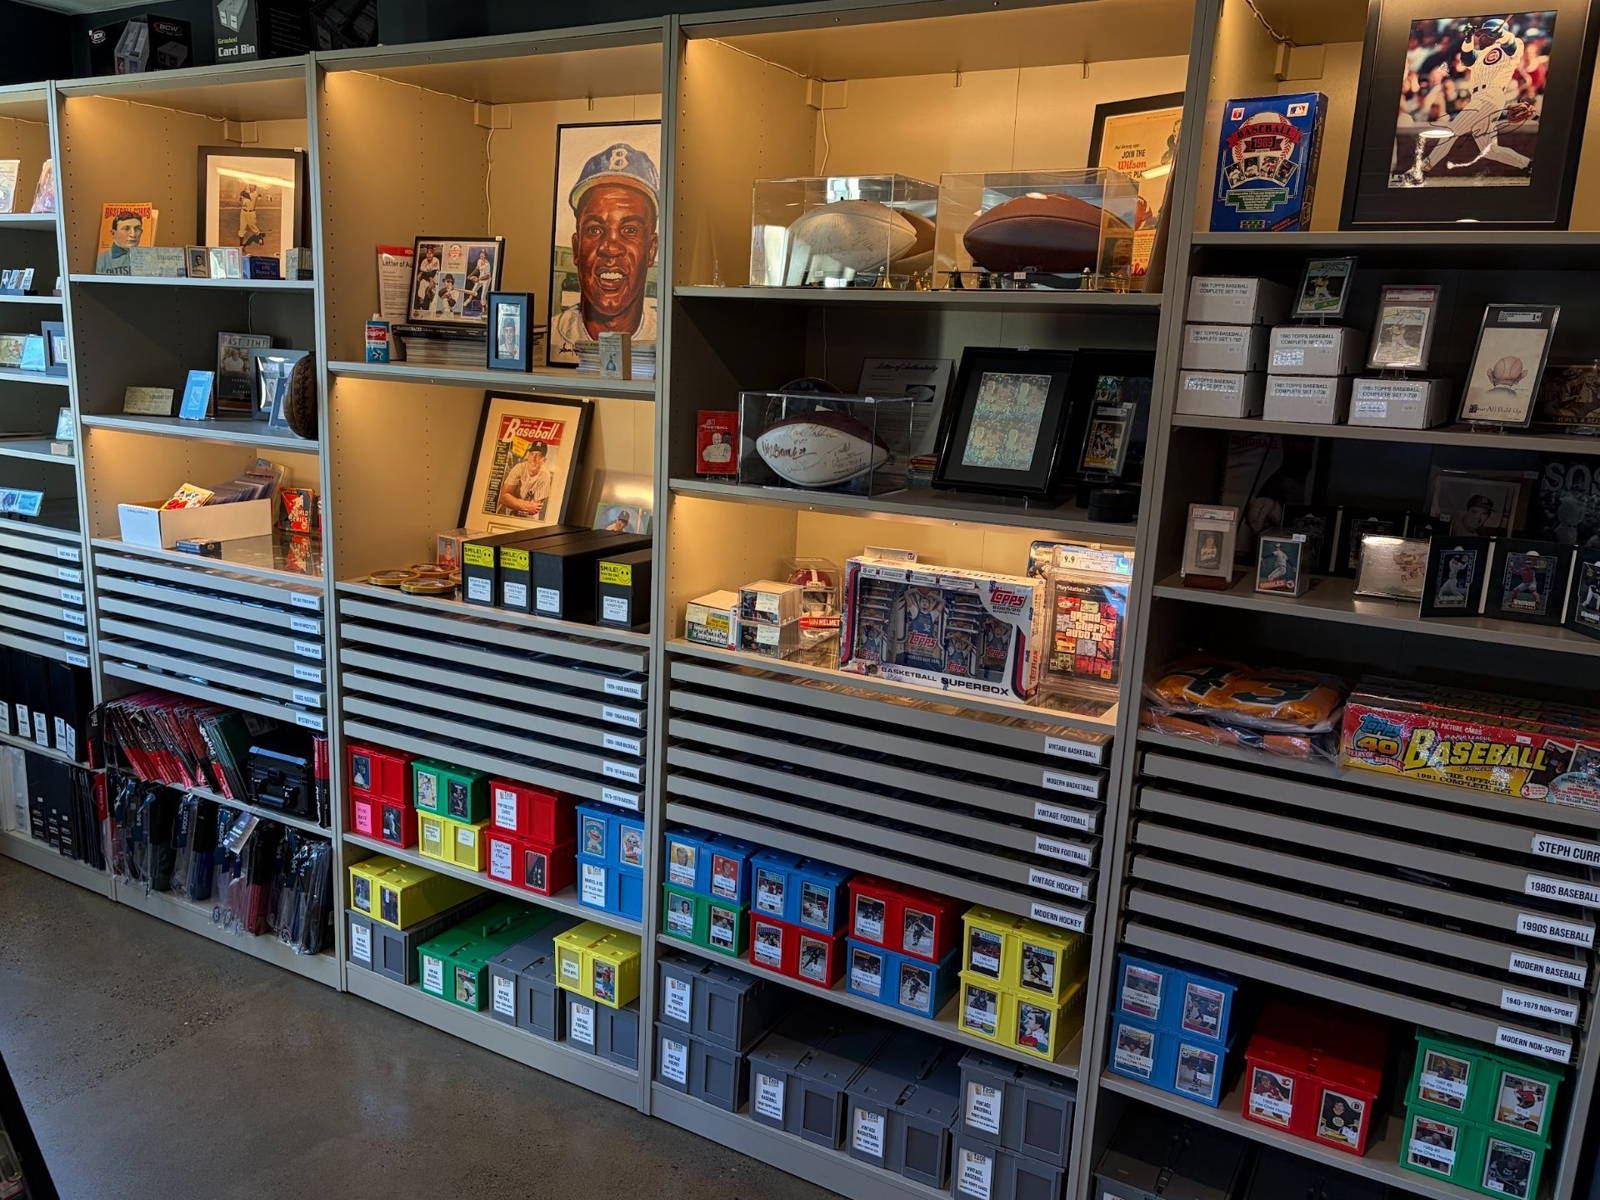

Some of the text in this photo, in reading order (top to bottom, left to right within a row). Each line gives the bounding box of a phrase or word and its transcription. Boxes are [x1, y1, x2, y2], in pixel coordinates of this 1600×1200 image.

[217, 43, 256, 58] Card Bin
[1237, 123, 1292, 139] BASEBALL
[1253, 136, 1273, 149] 1989
[1121, 149, 1146, 159] JOIN THE
[1117, 160, 1147, 171] Wilson
[382, 260, 399, 268] Letter
[1362, 391, 1391, 399] COMPLETE
[502, 418, 560, 443] Baseball
[464, 547, 482, 555] SMILE!
[1064, 555, 1076, 564] 9.9
[600, 565, 619, 573] SMILE!
[991, 587, 1027, 608] Topps
[819, 619, 840, 627] HELMET
[1070, 610, 1101, 622] grand
[1066, 628, 1091, 639] auto
[1074, 620, 1107, 634] theft
[908, 631, 937, 649] Topps
[880, 666, 1010, 698] BASKETBALL SUPERBOX
[1360, 714, 1403, 737] Topps
[1440, 722, 1464, 733] PICTURE
[1048, 743, 1097, 759] VINTAGE BASKETBALL
[1356, 735, 1400, 756] 40
[1403, 727, 1549, 772] BASEBALL
[1046, 777, 1095, 793] MODERN BASKETBALL
[1439, 777, 1491, 790] COMPLETE
[1444, 771, 1511, 789] THE OFFICIAL
[1523, 785, 1530, 797] 3
[1037, 808, 1087, 827] VINTAGE FOOTBALL
[1038, 842, 1088, 861] MODERN FOOTBALL
[1538, 840, 1571, 857] STEPH
[1031, 874, 1080, 894] VINTAGE HOCKEY
[1530, 881, 1600, 903] 1980S BASEBALL
[1034, 908, 1082, 928] MODERN HOCKEY
[1522, 920, 1590, 943] 1990S BASEBALL
[1513, 959, 1582, 982] MODERN BASEBALL
[1506, 996, 1574, 1018] 1940-1979 NON-SPORT
[1500, 1033, 1567, 1057] MODERN NON-SPORT
